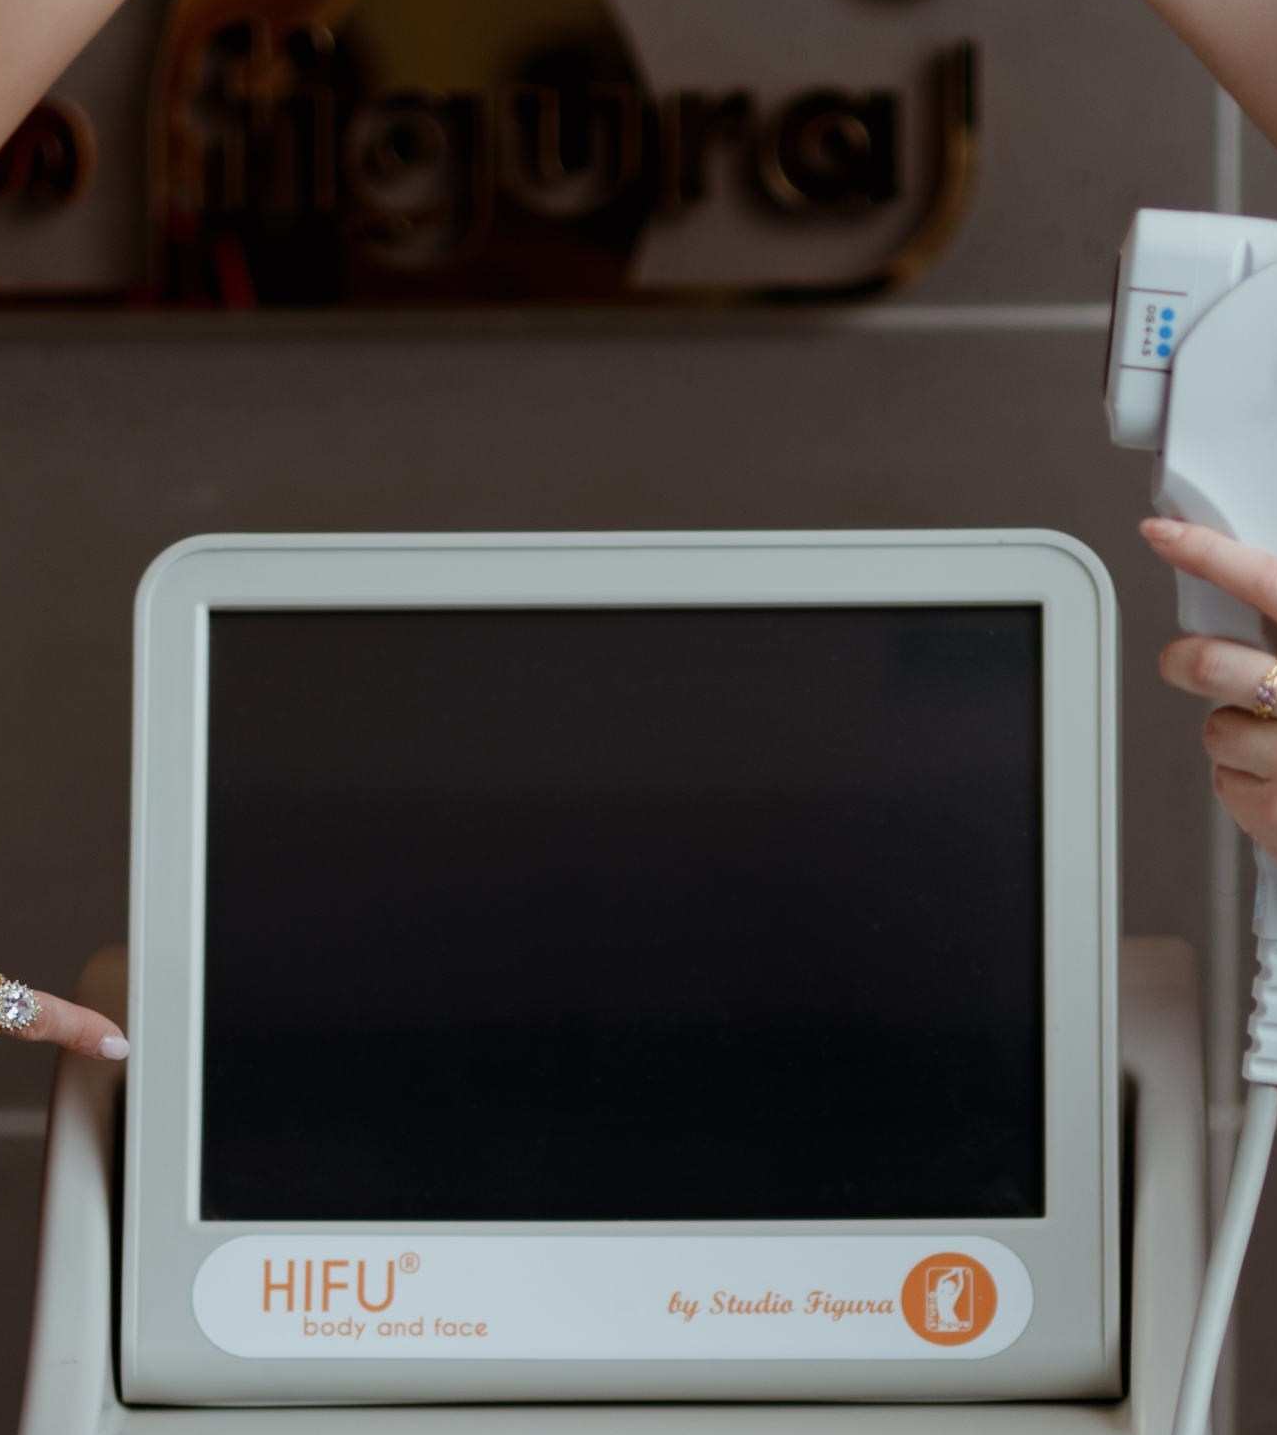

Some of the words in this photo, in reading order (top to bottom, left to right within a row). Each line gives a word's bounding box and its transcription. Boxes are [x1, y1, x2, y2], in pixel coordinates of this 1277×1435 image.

[668, 1291, 701, 1322] by
[709, 1290, 795, 1315] Studio
[804, 1290, 896, 1322] Figura
[303, 1316, 367, 1341] body
[377, 1316, 424, 1337] and
[434, 1317, 489, 1337] face
